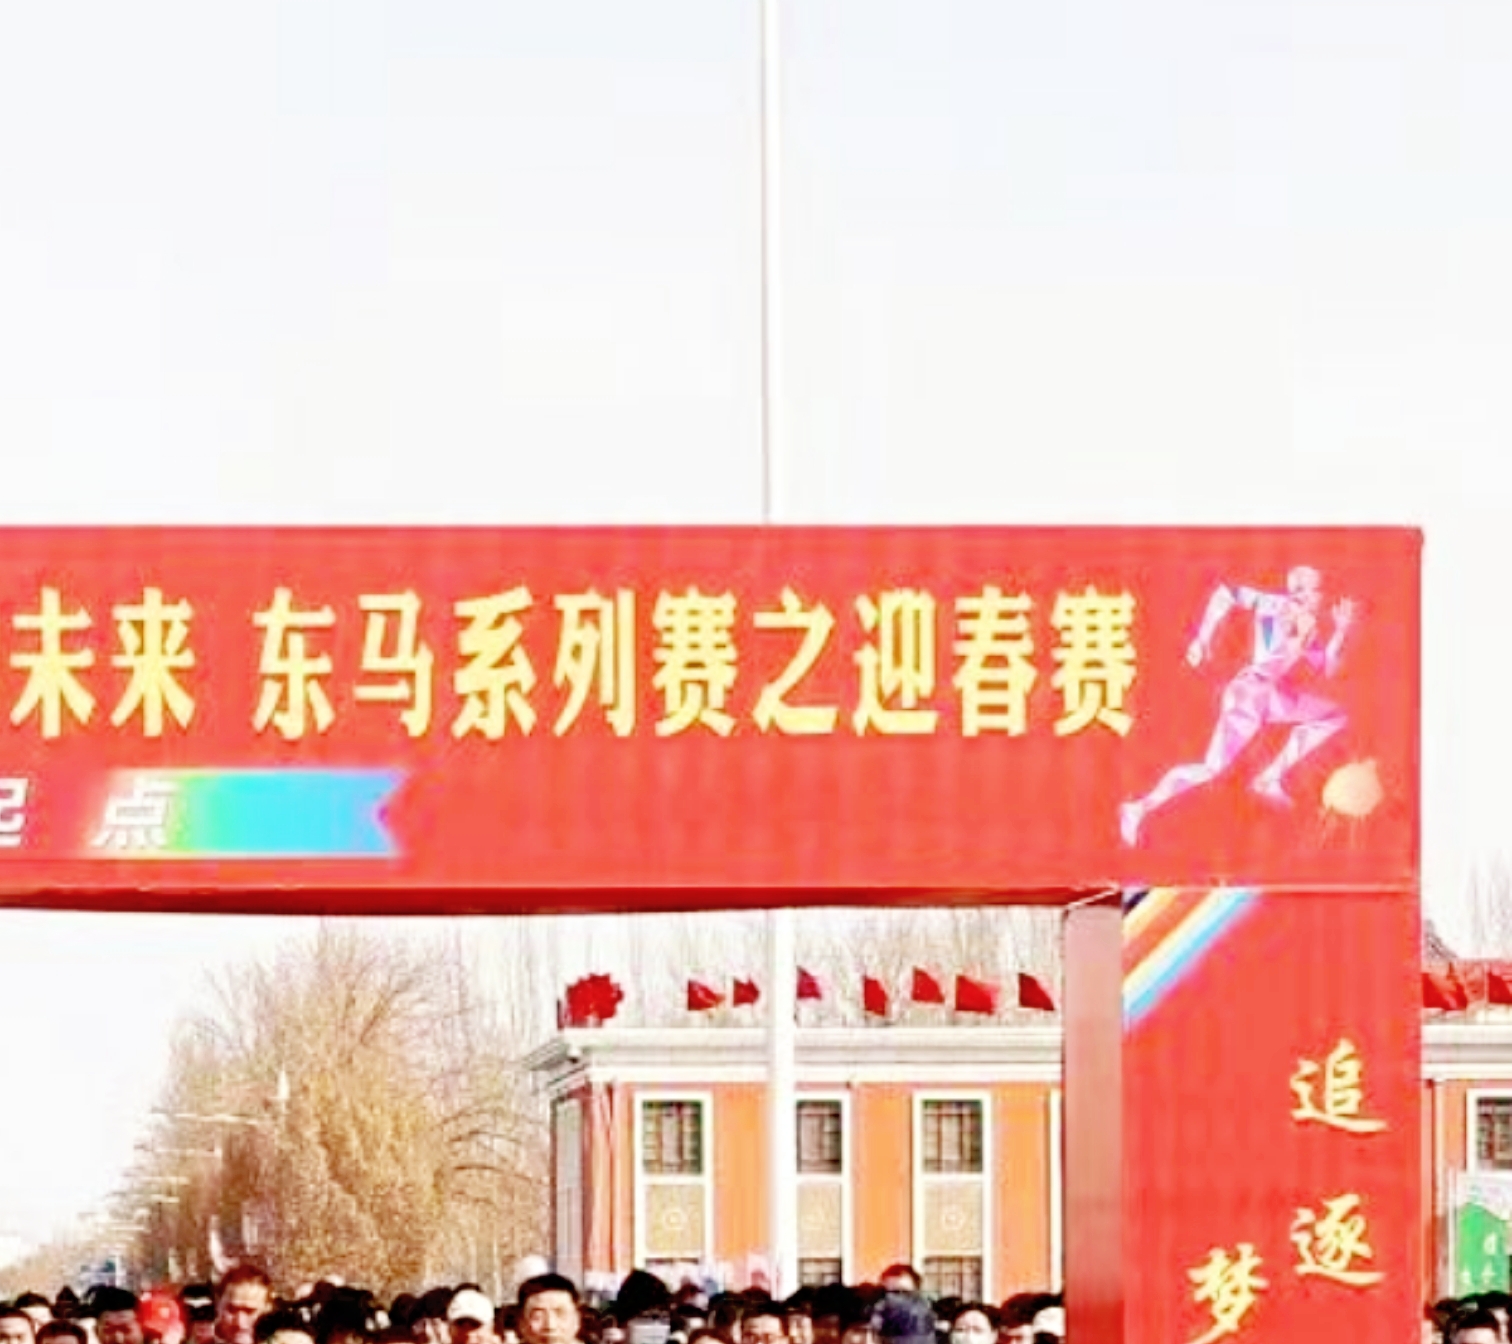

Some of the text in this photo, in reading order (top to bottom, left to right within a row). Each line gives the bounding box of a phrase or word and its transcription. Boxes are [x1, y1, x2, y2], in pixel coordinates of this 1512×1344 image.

[252, 586, 1138, 740] 东马系列赛之迎春赛
